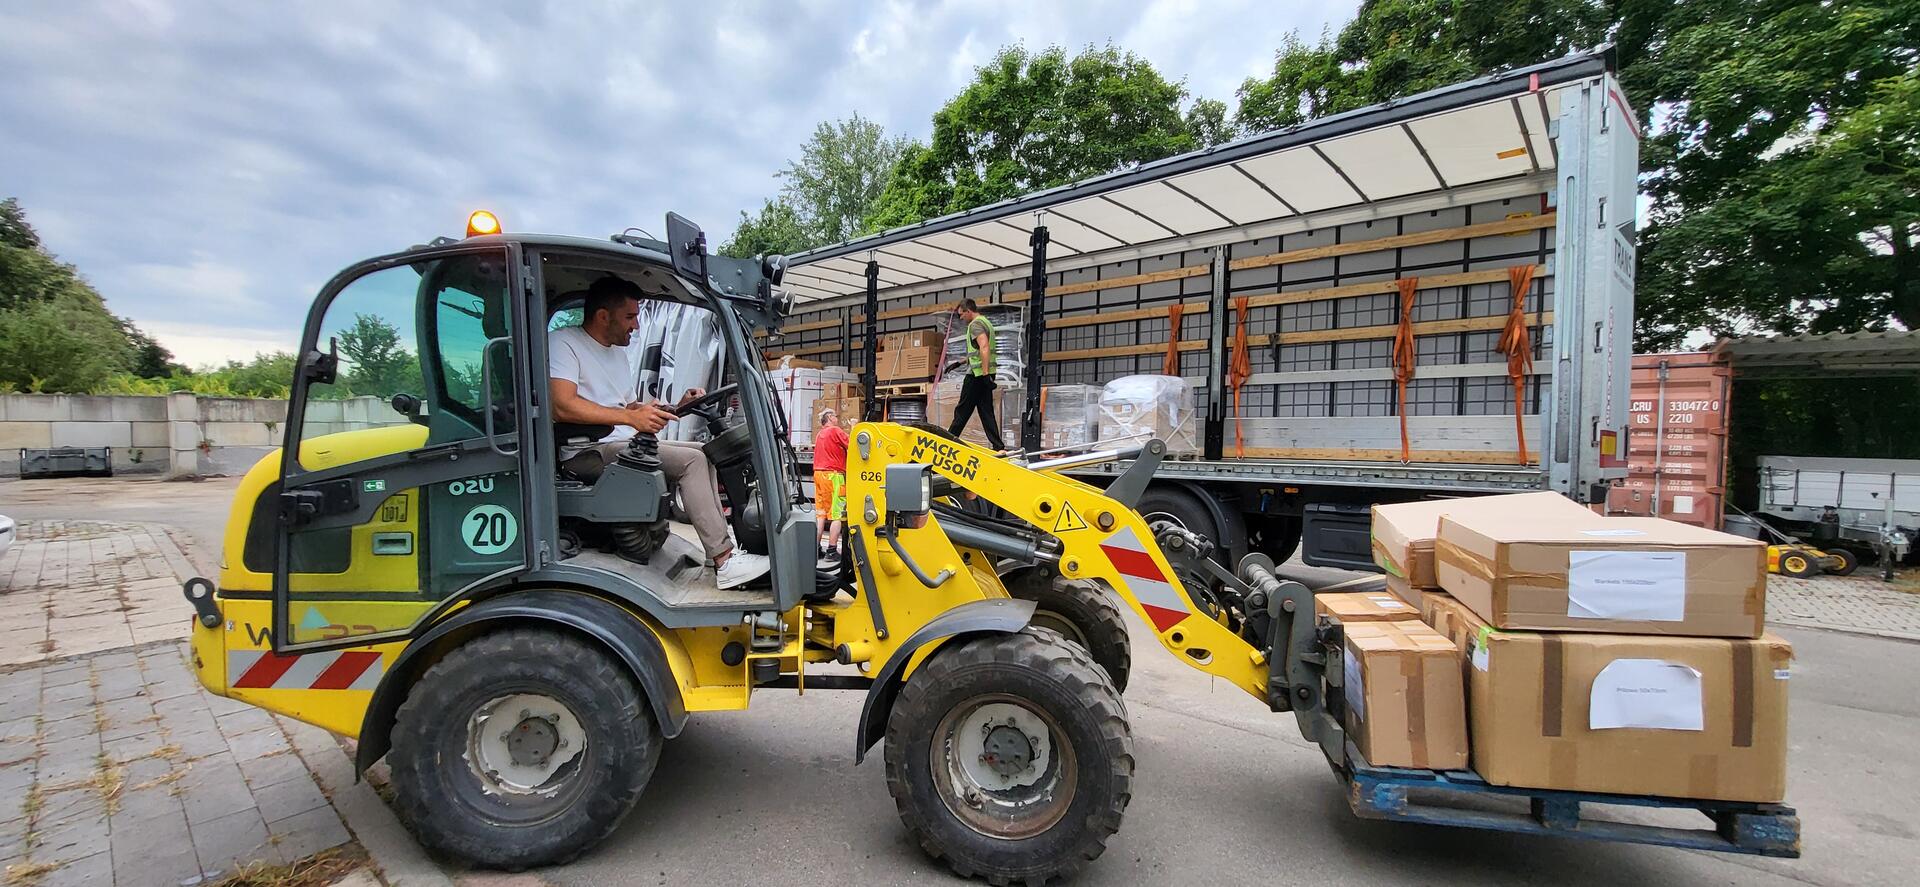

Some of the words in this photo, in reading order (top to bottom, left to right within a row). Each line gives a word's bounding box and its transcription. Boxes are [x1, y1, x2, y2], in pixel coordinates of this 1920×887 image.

[1669, 401, 1709, 411] 330472
[1712, 401, 1719, 411] 0
[1637, 414, 1649, 424] US
[1669, 413, 1693, 424] 2210
[860, 472, 883, 482] 626
[472, 512, 507, 547] 20
